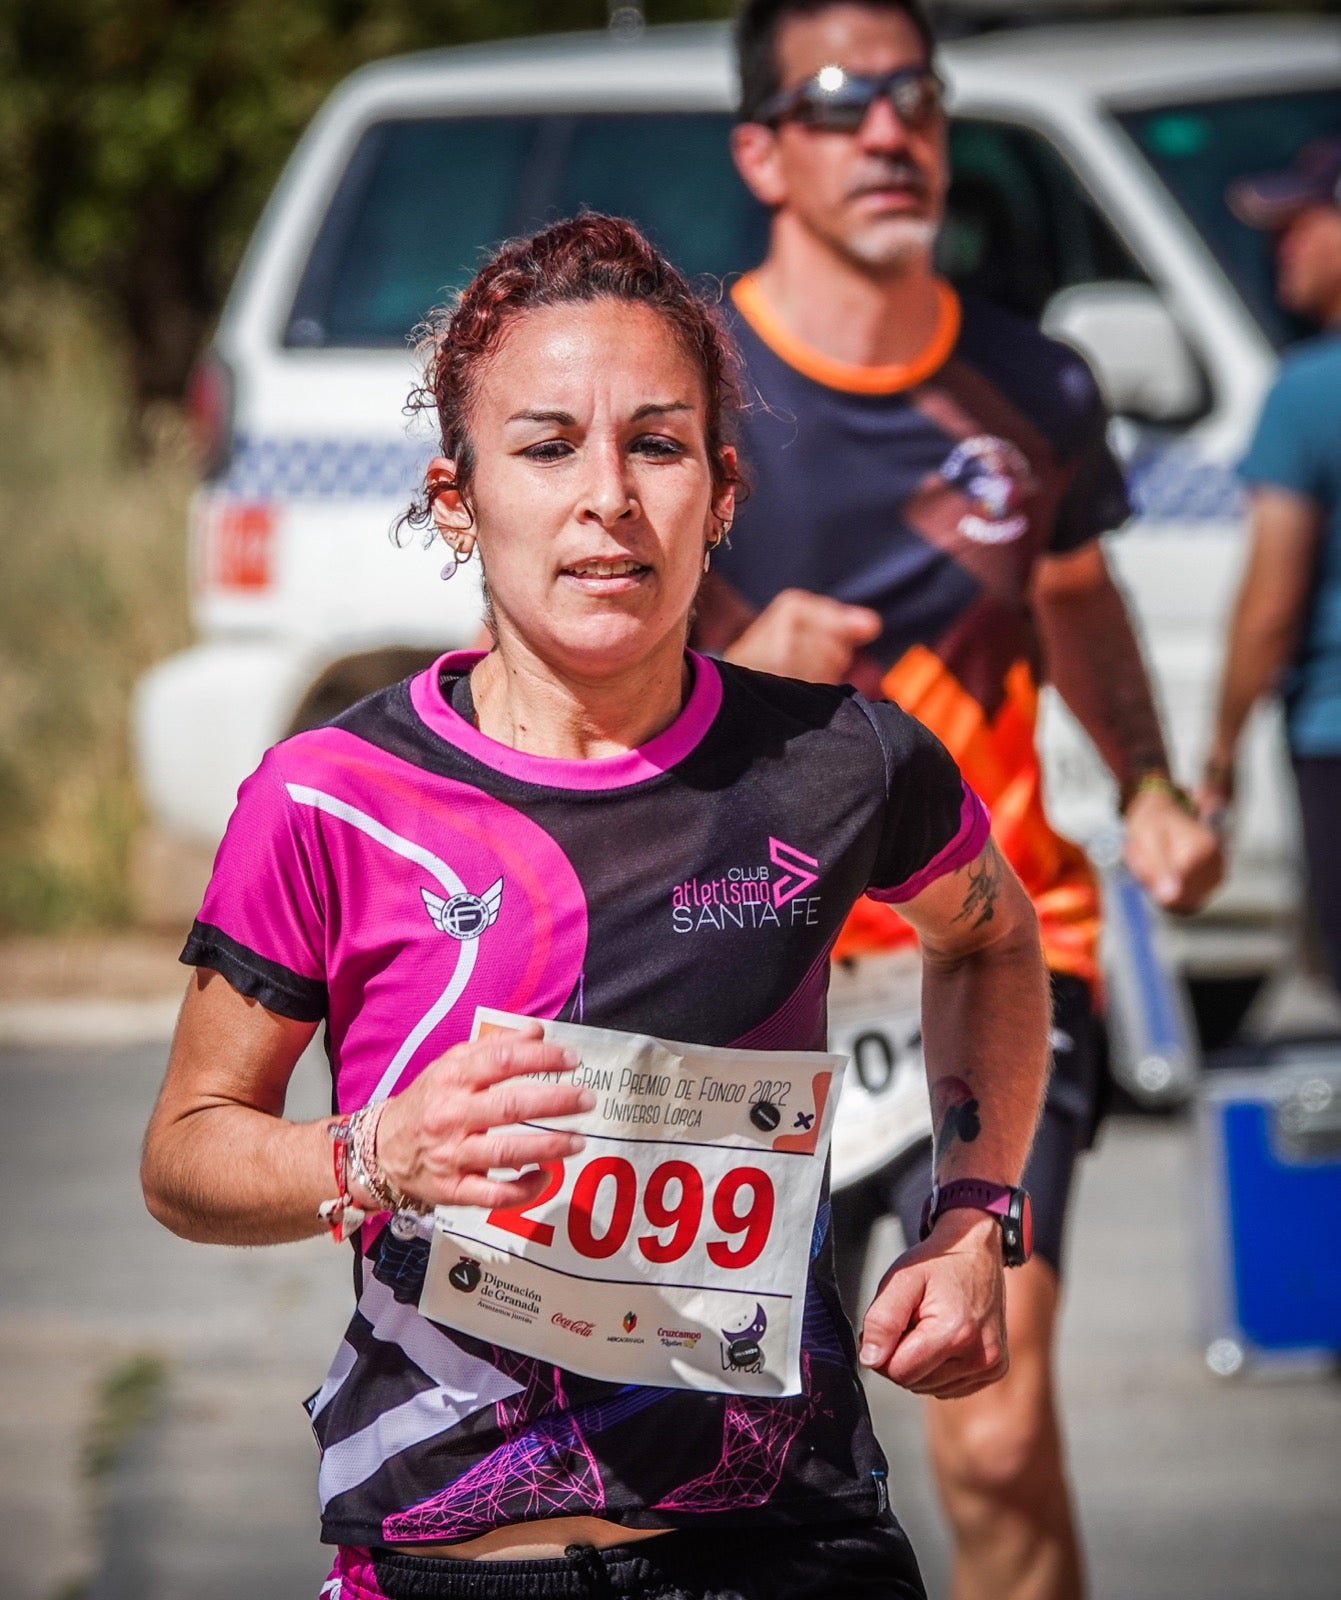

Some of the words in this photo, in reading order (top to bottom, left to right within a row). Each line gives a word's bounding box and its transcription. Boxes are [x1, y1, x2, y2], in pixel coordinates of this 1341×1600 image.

[727, 866, 770, 882] CLUB
[672, 877, 770, 908] atletismo
[672, 900, 781, 934] SANTA
[790, 896, 822, 927] FE
[570, 1060, 614, 1092] GRAN
[618, 1067, 672, 1099] PREMIO
[674, 1079, 693, 1101] DE
[699, 1076, 747, 1104] FONDO
[748, 1080, 792, 1107] 2022
[602, 1097, 660, 1125] UNIVERSO
[663, 1102, 703, 1129] LORCA
[486, 1156, 775, 1270] 2099
[480, 1284, 494, 1299] de
[495, 1288, 540, 1315] Granada
[483, 1271, 542, 1302] Diputación
[657, 1327, 702, 1341] Cruzcampo
